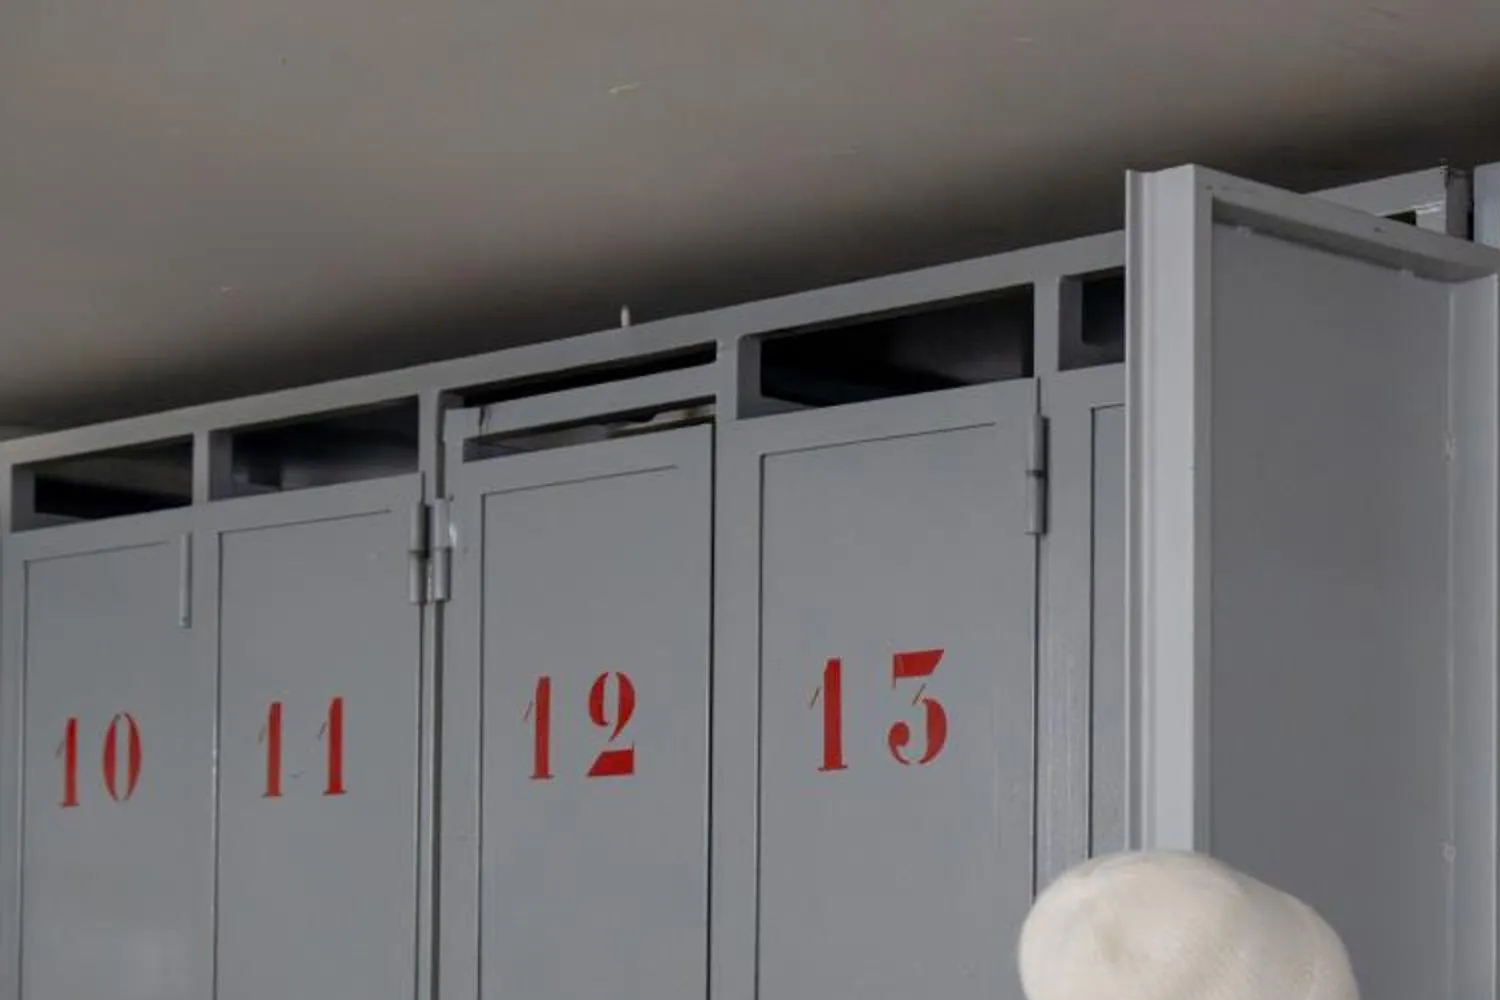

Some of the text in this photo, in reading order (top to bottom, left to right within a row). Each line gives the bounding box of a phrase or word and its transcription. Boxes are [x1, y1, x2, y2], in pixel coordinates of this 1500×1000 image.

[56, 711, 142, 808] 10
[257, 696, 348, 799] 11
[522, 670, 636, 780] 12
[808, 648, 948, 772] 13
